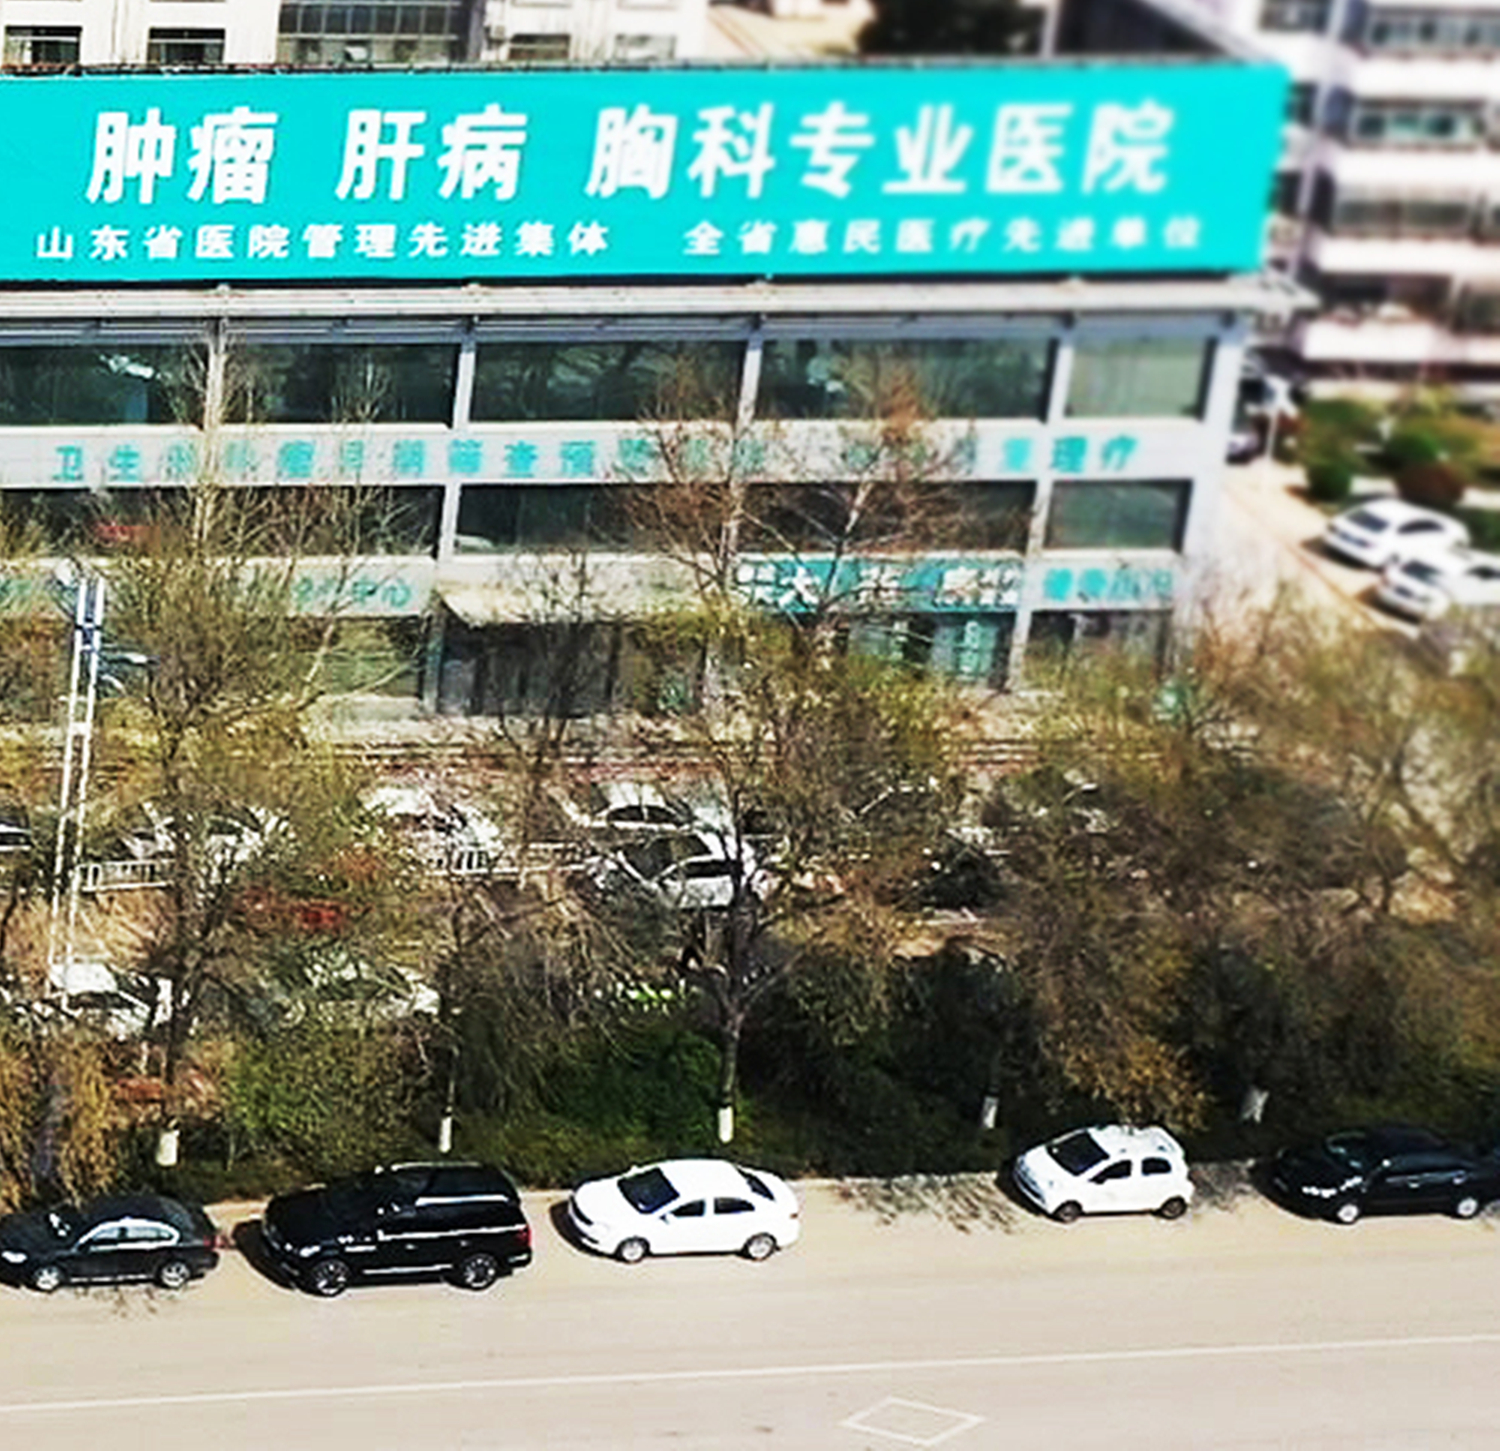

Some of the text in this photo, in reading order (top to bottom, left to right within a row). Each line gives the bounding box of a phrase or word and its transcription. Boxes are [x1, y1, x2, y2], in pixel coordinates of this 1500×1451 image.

[86, 99, 1175, 204] 肿瘤 肝病 胸科专业医院
[36, 215, 1202, 261] 山东省医院管理先进集体 全省惠民医疗先进单位
